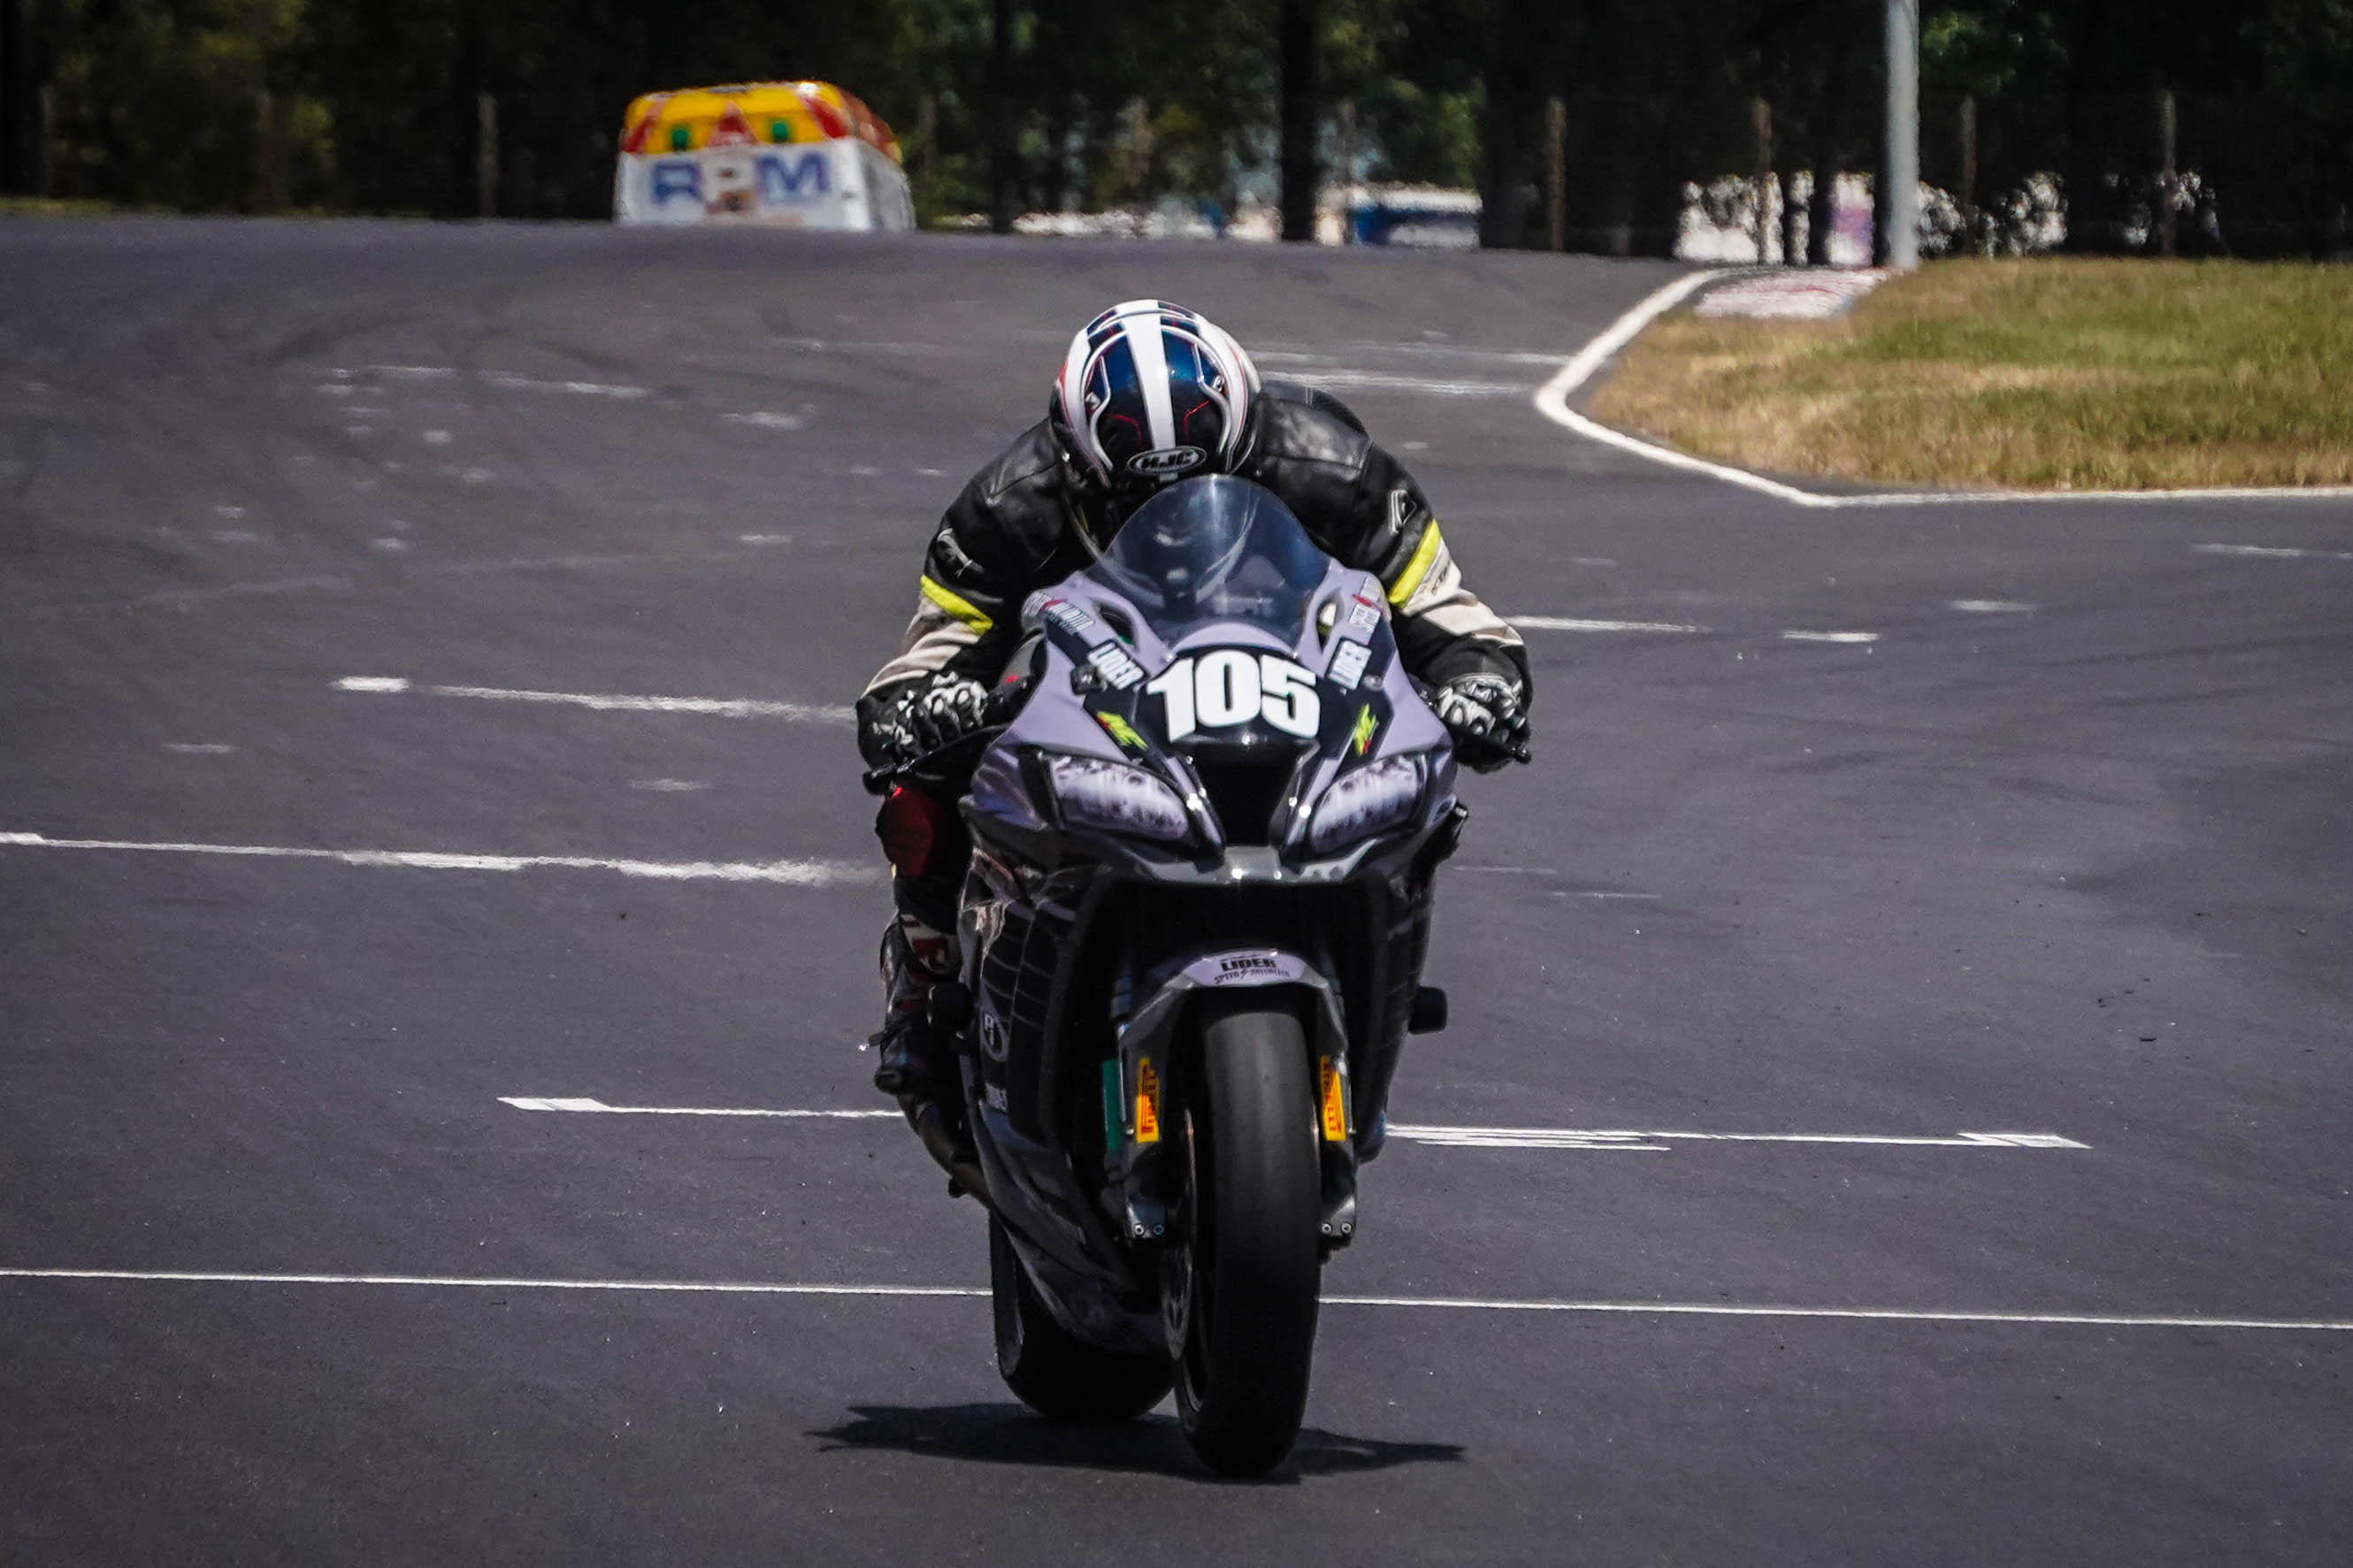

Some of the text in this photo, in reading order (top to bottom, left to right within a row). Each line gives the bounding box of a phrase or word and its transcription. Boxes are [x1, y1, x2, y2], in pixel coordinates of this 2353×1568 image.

[651, 150, 831, 208] RPM
[1141, 452, 1194, 469] HJC
[1147, 650, 1320, 743] 105
[1221, 958, 1277, 972] LIDER
